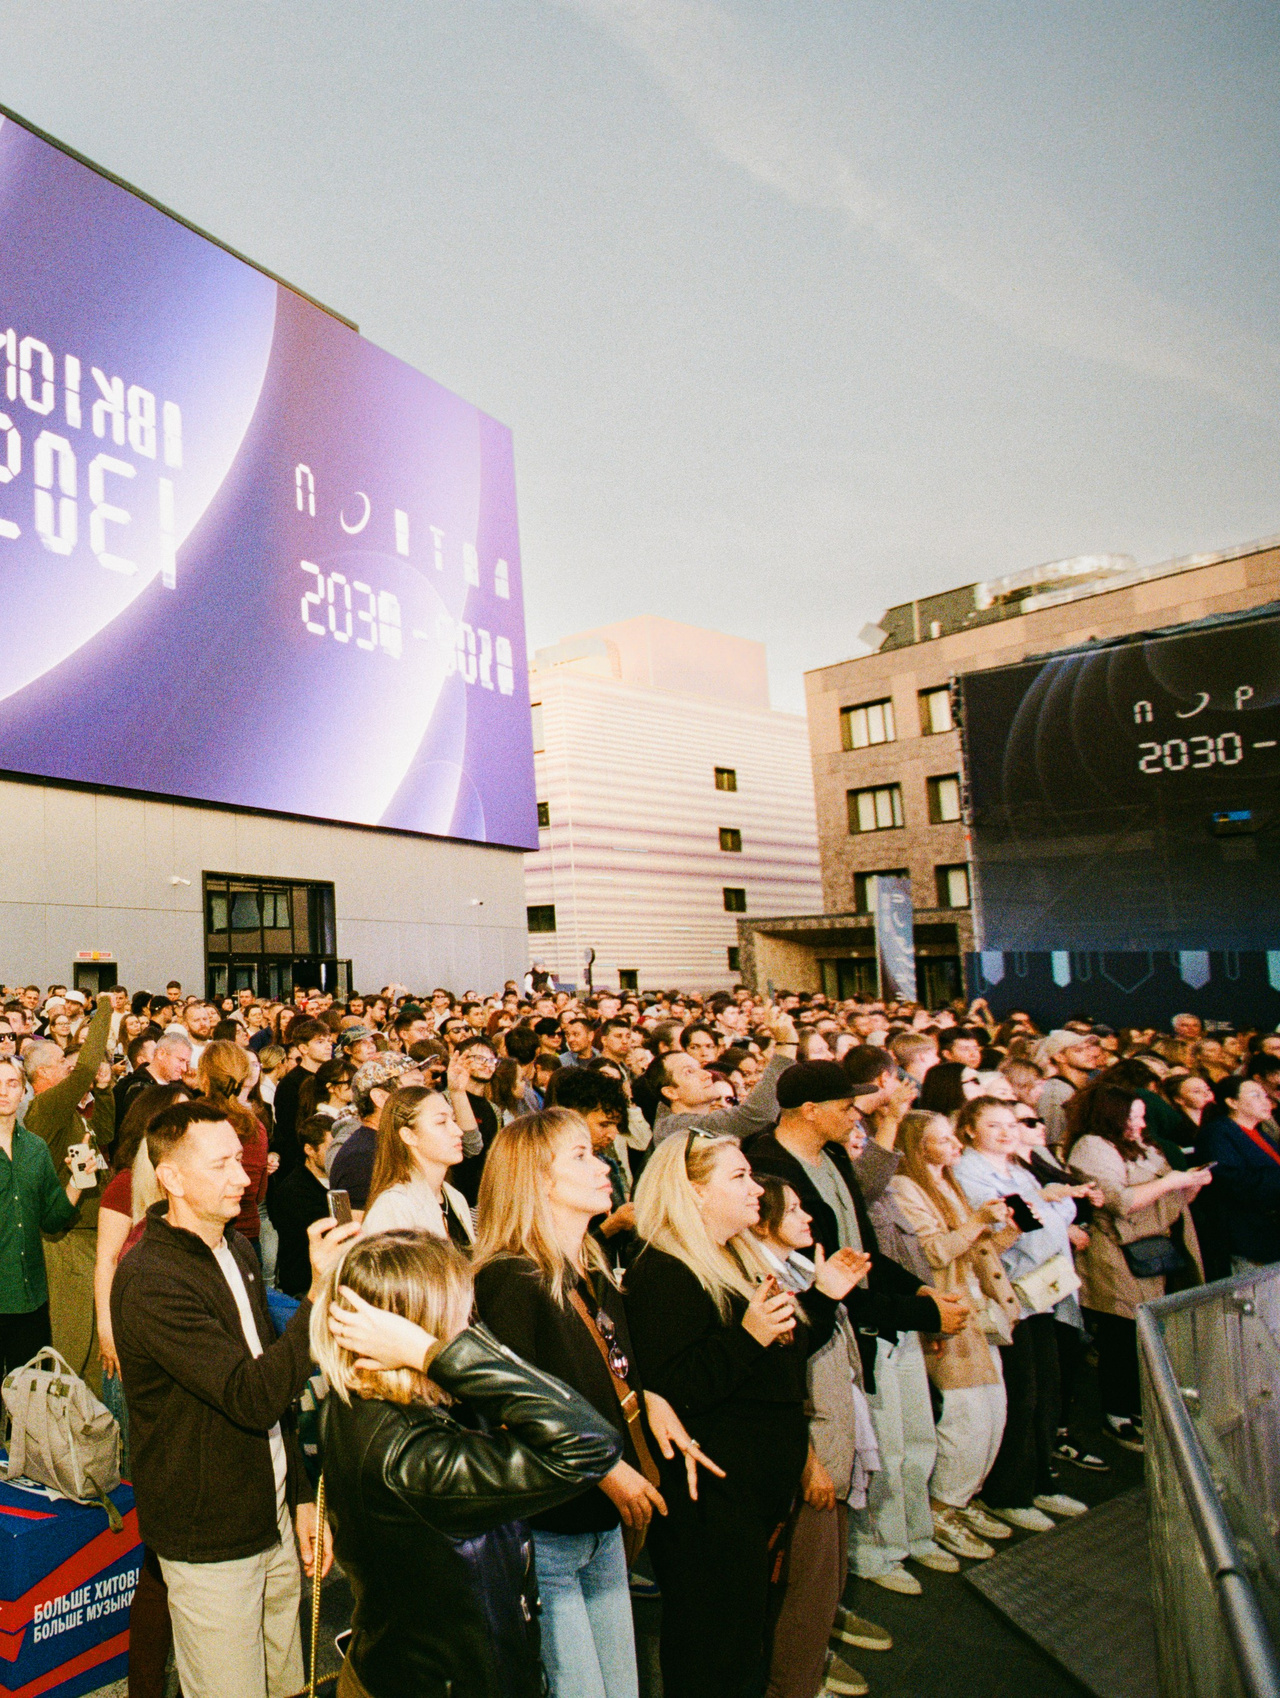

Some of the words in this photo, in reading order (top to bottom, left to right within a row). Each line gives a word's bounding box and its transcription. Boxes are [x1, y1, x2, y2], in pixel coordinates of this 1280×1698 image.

[34, 1585, 91, 1625] БОЛЬШЕ
[94, 1567, 140, 1601] ХИТОВ!
[33, 1608, 84, 1644] БОЛЬШЕ
